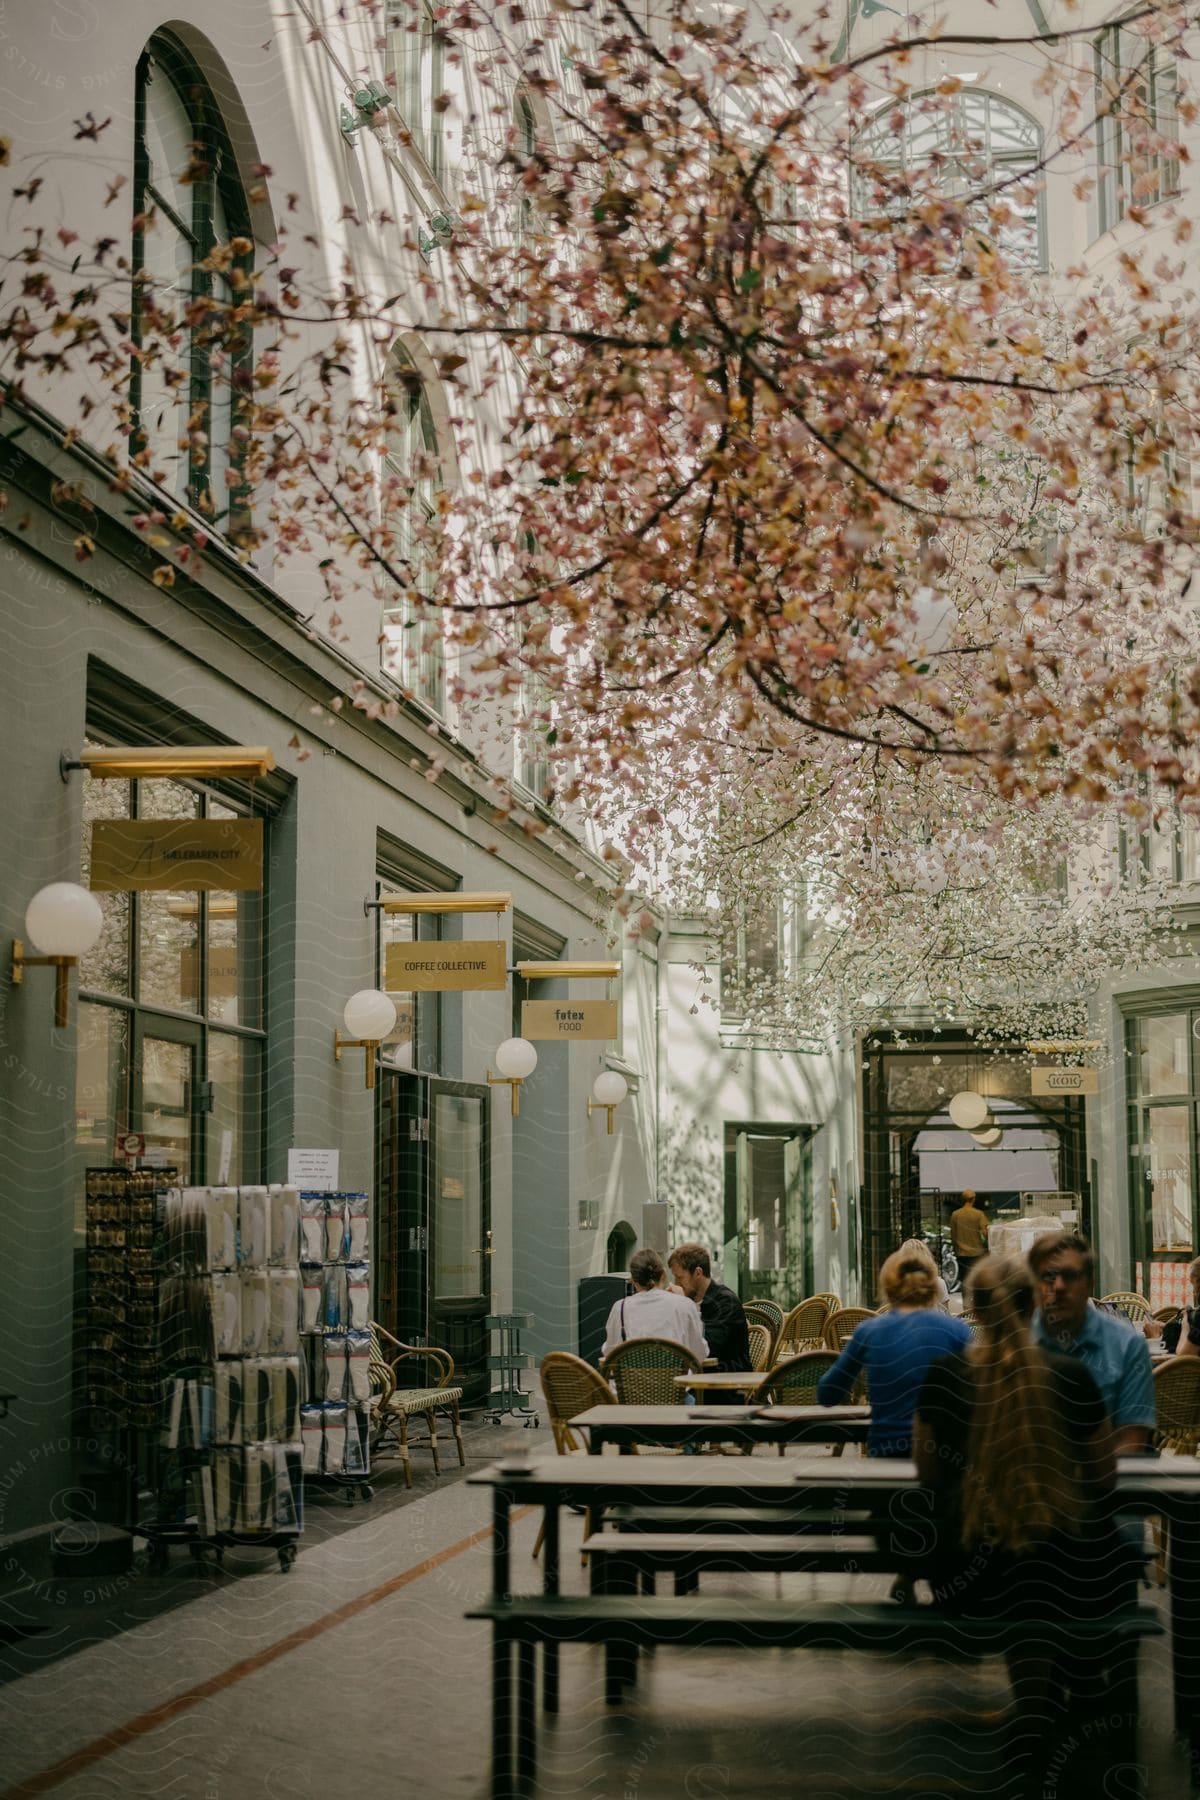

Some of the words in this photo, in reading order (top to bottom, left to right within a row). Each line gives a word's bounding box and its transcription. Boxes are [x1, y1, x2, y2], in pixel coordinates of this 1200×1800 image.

[220, 849, 240, 859] CITY
[404, 961, 435, 971] COFFEE
[437, 960, 487, 971] COLLECTIVE
[558, 1022, 582, 1031] FOOD
